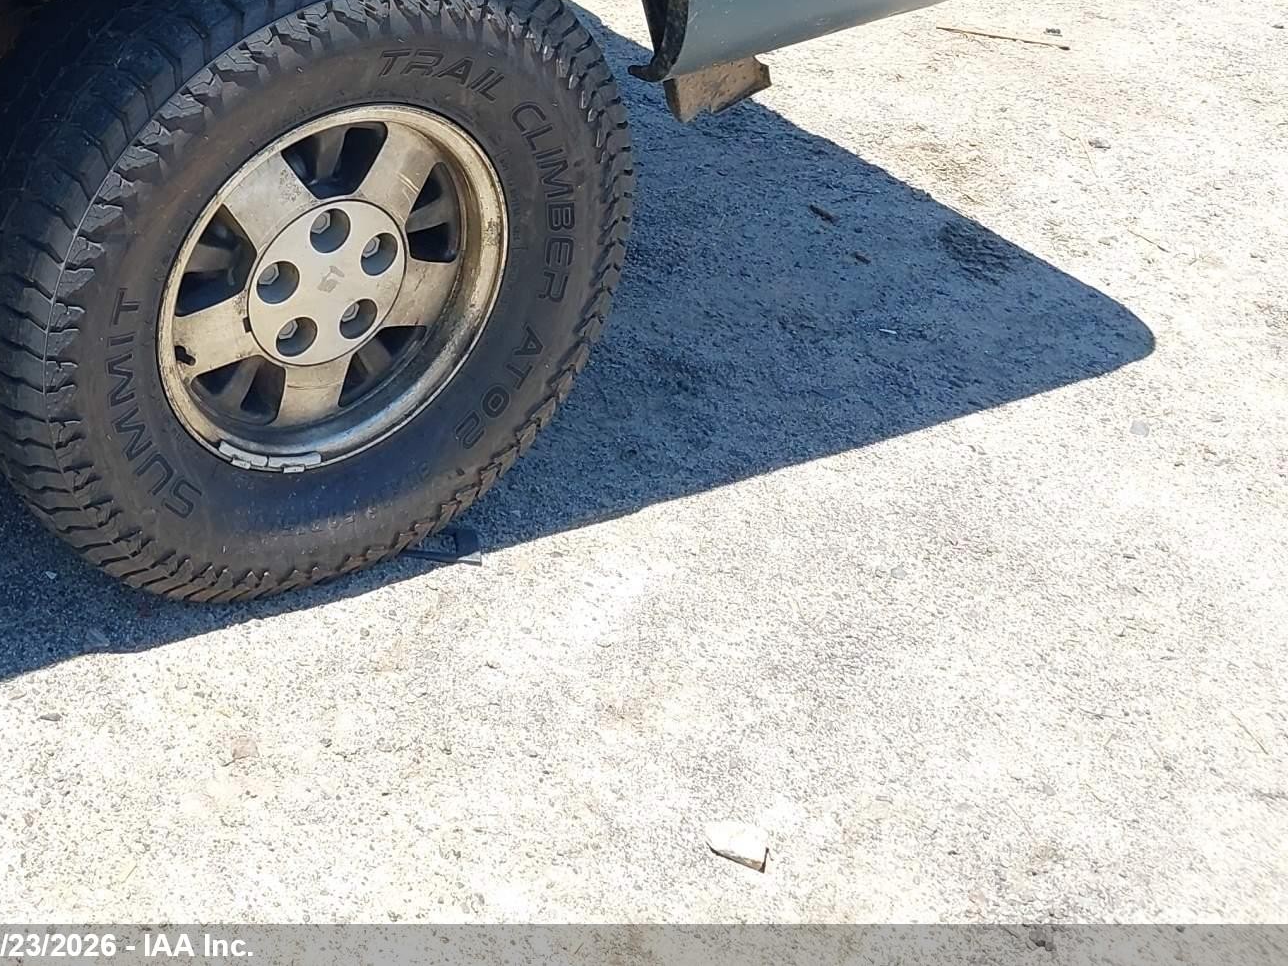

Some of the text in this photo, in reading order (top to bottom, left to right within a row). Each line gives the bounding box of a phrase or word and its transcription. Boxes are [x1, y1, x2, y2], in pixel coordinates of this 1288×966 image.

[378, 48, 507, 103] TRAIL
[511, 100, 576, 304] CLIMBER
[105, 287, 204, 520] SUMMIT
